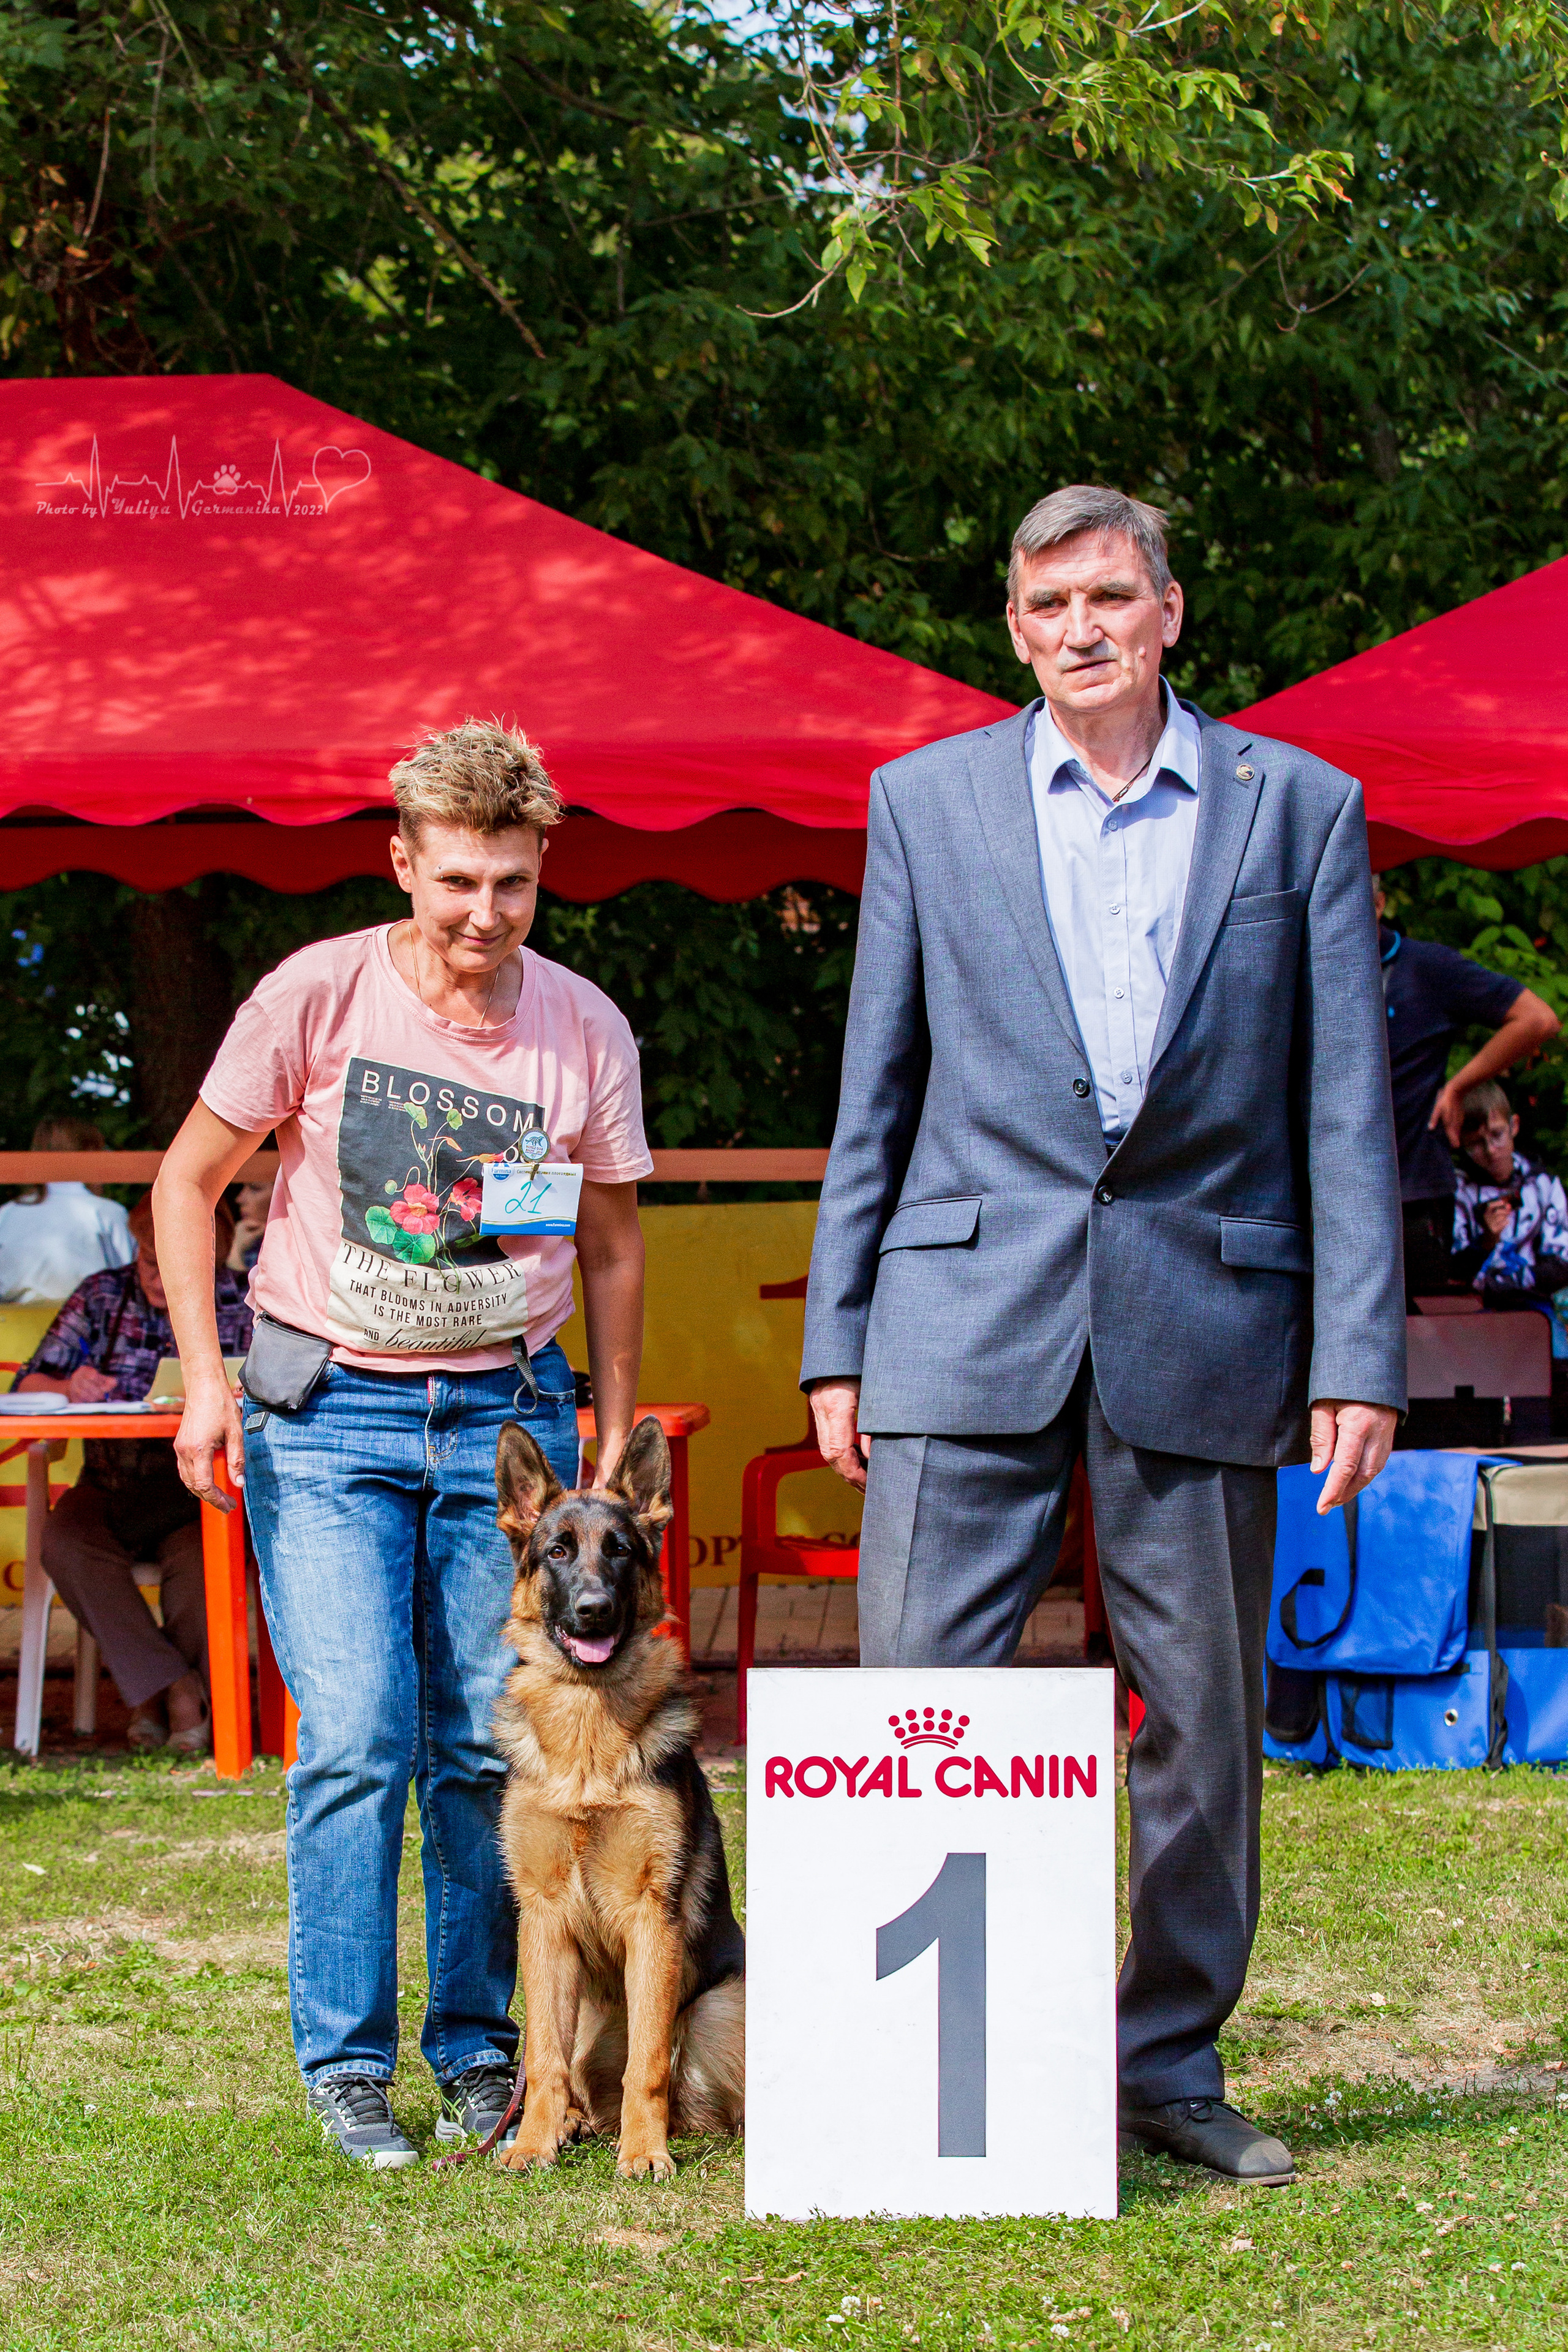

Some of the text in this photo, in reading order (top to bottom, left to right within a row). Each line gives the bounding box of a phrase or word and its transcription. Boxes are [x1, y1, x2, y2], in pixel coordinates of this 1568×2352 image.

[361, 1069, 534, 1133] BLOSSOM
[505, 1181, 552, 1214] 21
[343, 1243, 521, 1292] THE FLOWER
[349, 1280, 507, 1313] THAT BLOOMS IN ADVERSITY
[374, 1304, 482, 1327] IS THE MOST RARE
[364, 1328, 488, 1351] AND beautiful
[765, 1754, 1098, 1799] ROYAL CANIN
[876, 1852, 987, 2158] 1
